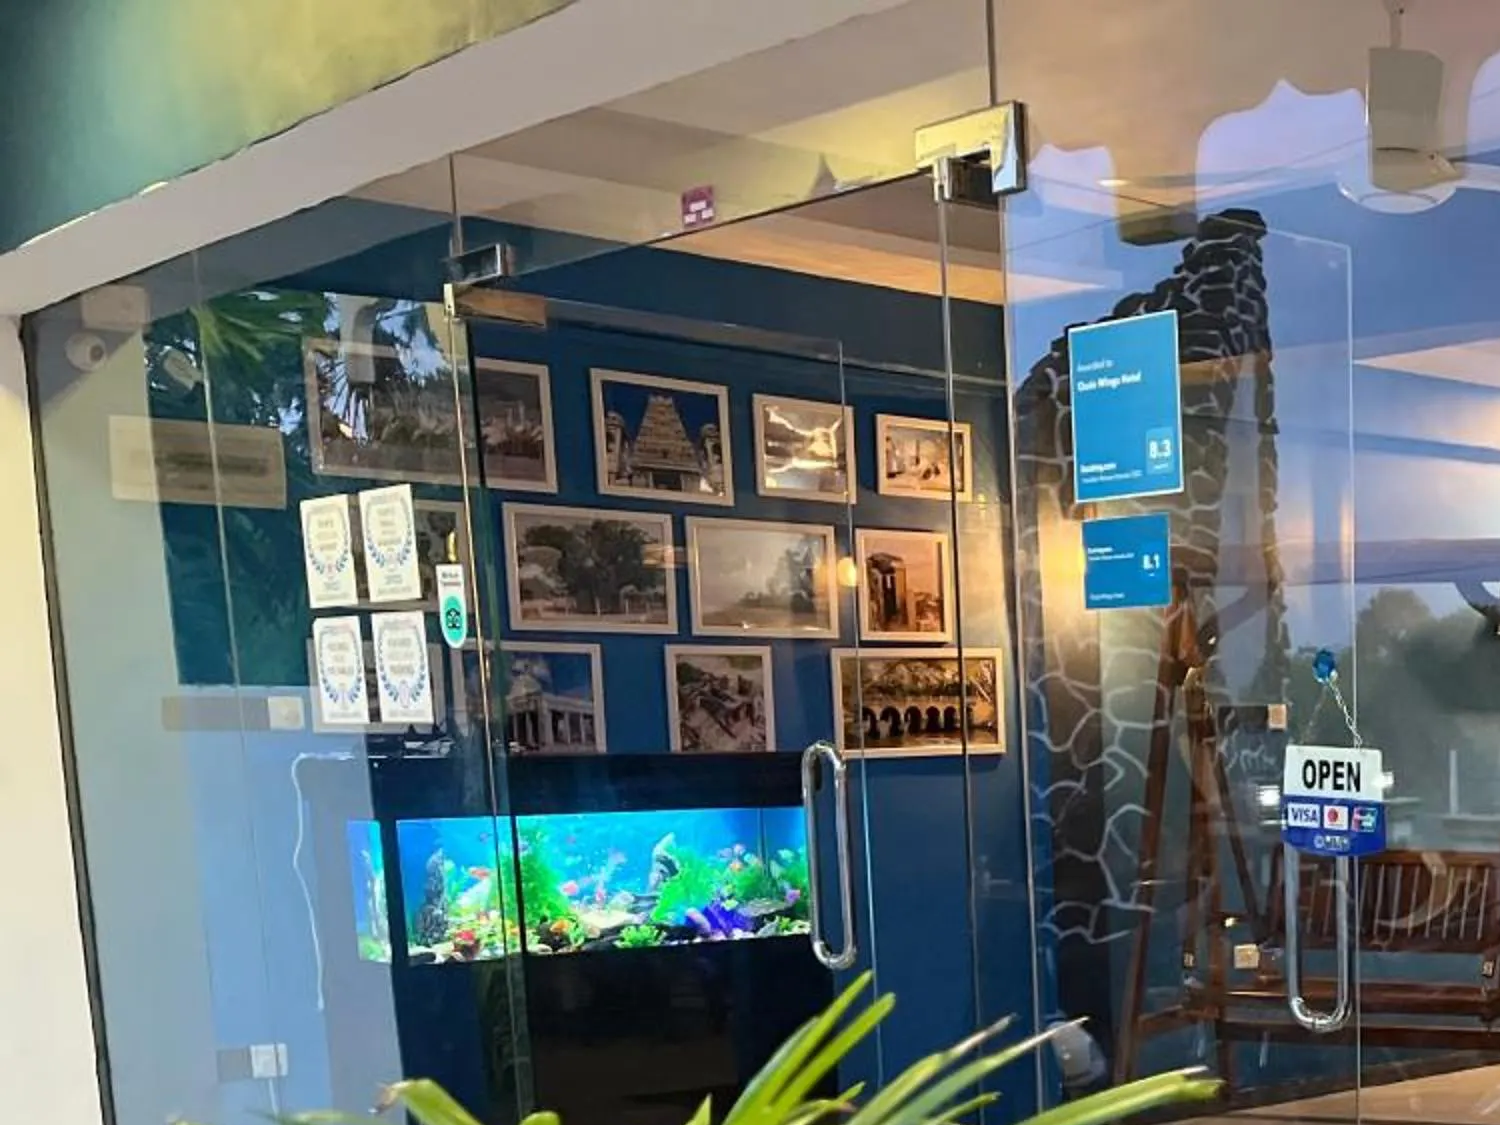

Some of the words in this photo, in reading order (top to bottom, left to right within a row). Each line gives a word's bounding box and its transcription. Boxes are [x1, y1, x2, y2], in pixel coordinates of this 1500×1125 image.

[1149, 439, 1172, 459] 8.3
[1302, 759, 1361, 792] OPEN
[1291, 807, 1319, 822] VISA
